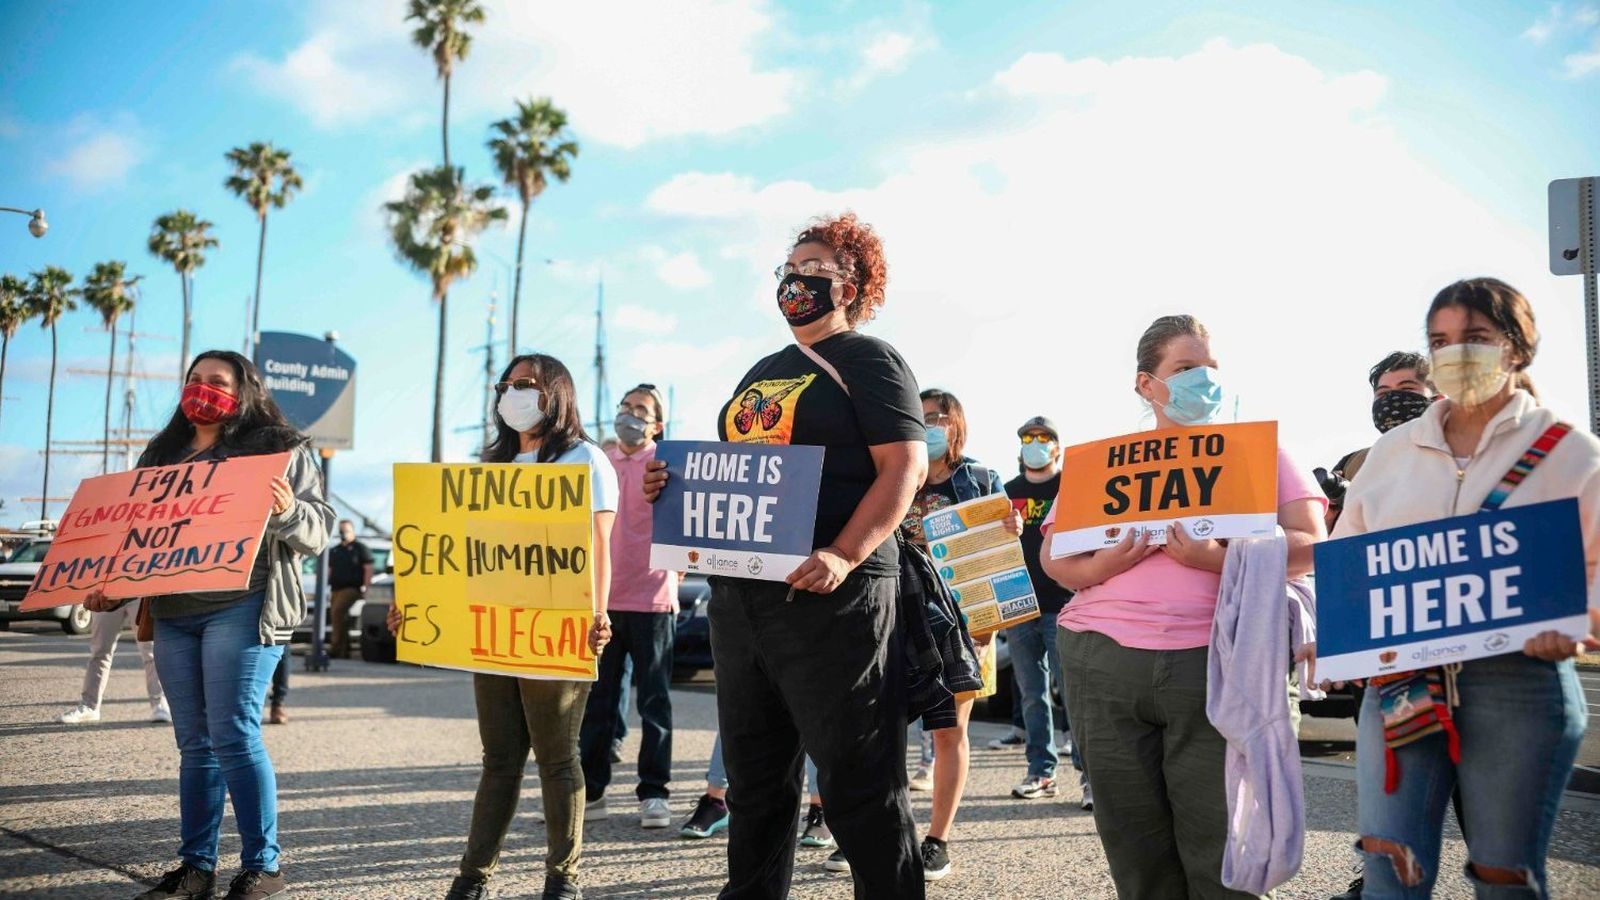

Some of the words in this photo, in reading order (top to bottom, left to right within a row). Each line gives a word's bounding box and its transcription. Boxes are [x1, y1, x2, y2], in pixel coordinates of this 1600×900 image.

[264, 359, 308, 379] County
[310, 364, 348, 380] Admin
[264, 375, 315, 396] Building
[684, 451, 752, 483] HOME
[757, 455, 783, 485] IS
[1107, 437, 1179, 468] HERE
[1188, 433, 1225, 458] TO
[441, 467, 585, 513] NINGUN
[1103, 466, 1223, 516] STAY
[56, 493, 235, 537] IGNORANCE
[123, 519, 192, 551] NOT
[683, 491, 778, 543] HERE
[33, 536, 254, 592] IMMIGRANTS
[395, 524, 460, 577] SER
[466, 536, 586, 577] HUMANO
[707, 554, 738, 570] alliance
[1366, 529, 1469, 577] HOME
[1479, 521, 1519, 558] IS
[1012, 596, 1035, 611] ACLU
[1369, 565, 1524, 640] HERE
[401, 603, 441, 646] ES
[469, 605, 595, 661] ILEGAL
[1411, 643, 1467, 662] alliance
